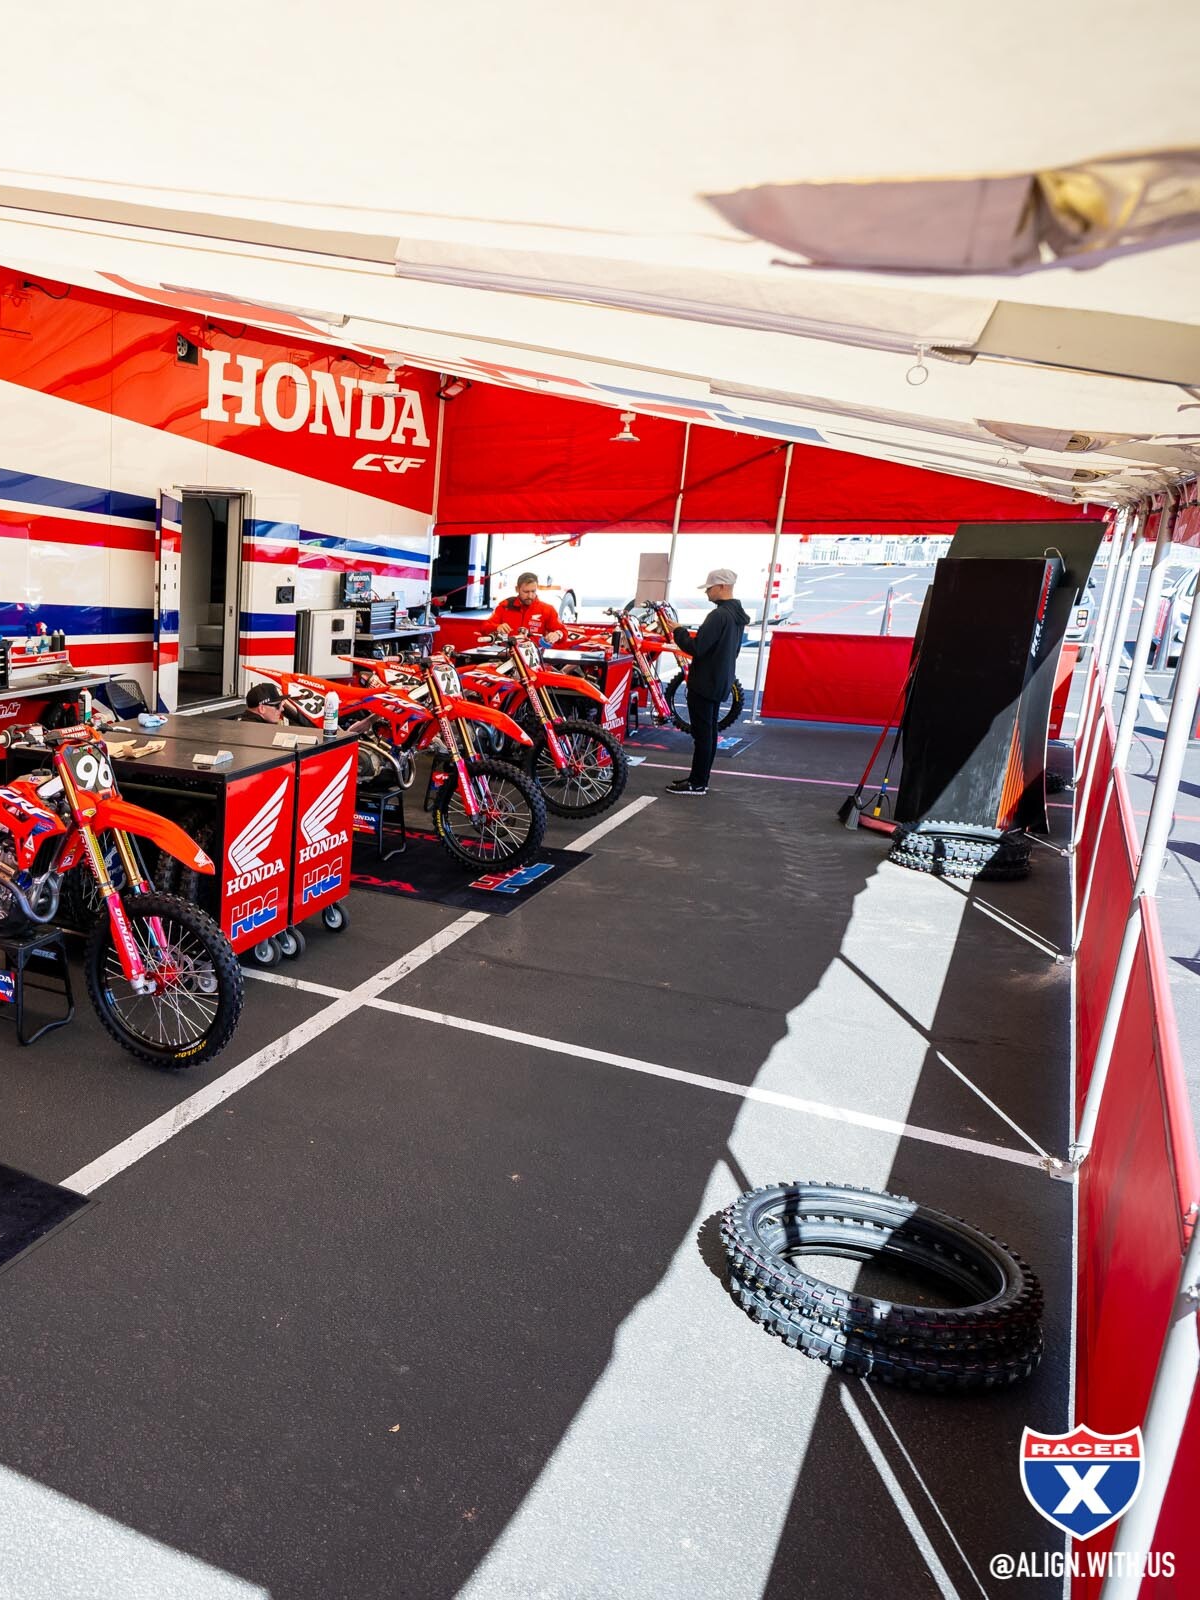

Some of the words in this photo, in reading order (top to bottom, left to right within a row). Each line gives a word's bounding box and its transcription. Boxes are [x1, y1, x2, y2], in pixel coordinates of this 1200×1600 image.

[200, 347, 430, 448] HONDA
[352, 453, 426, 474] CRF
[298, 678, 326, 690] HONDA
[390, 664, 416, 674] HONDA
[294, 688, 326, 714] 23
[602, 717, 624, 731] HONDA
[76, 755, 113, 789] 96
[353, 813, 376, 823] ONDA
[299, 829, 349, 864] HONDA
[226, 859, 286, 898] HONDA
[302, 856, 343, 905] HRC
[231, 887, 279, 941] HRC
[114, 907, 137, 961] DUNLOP
